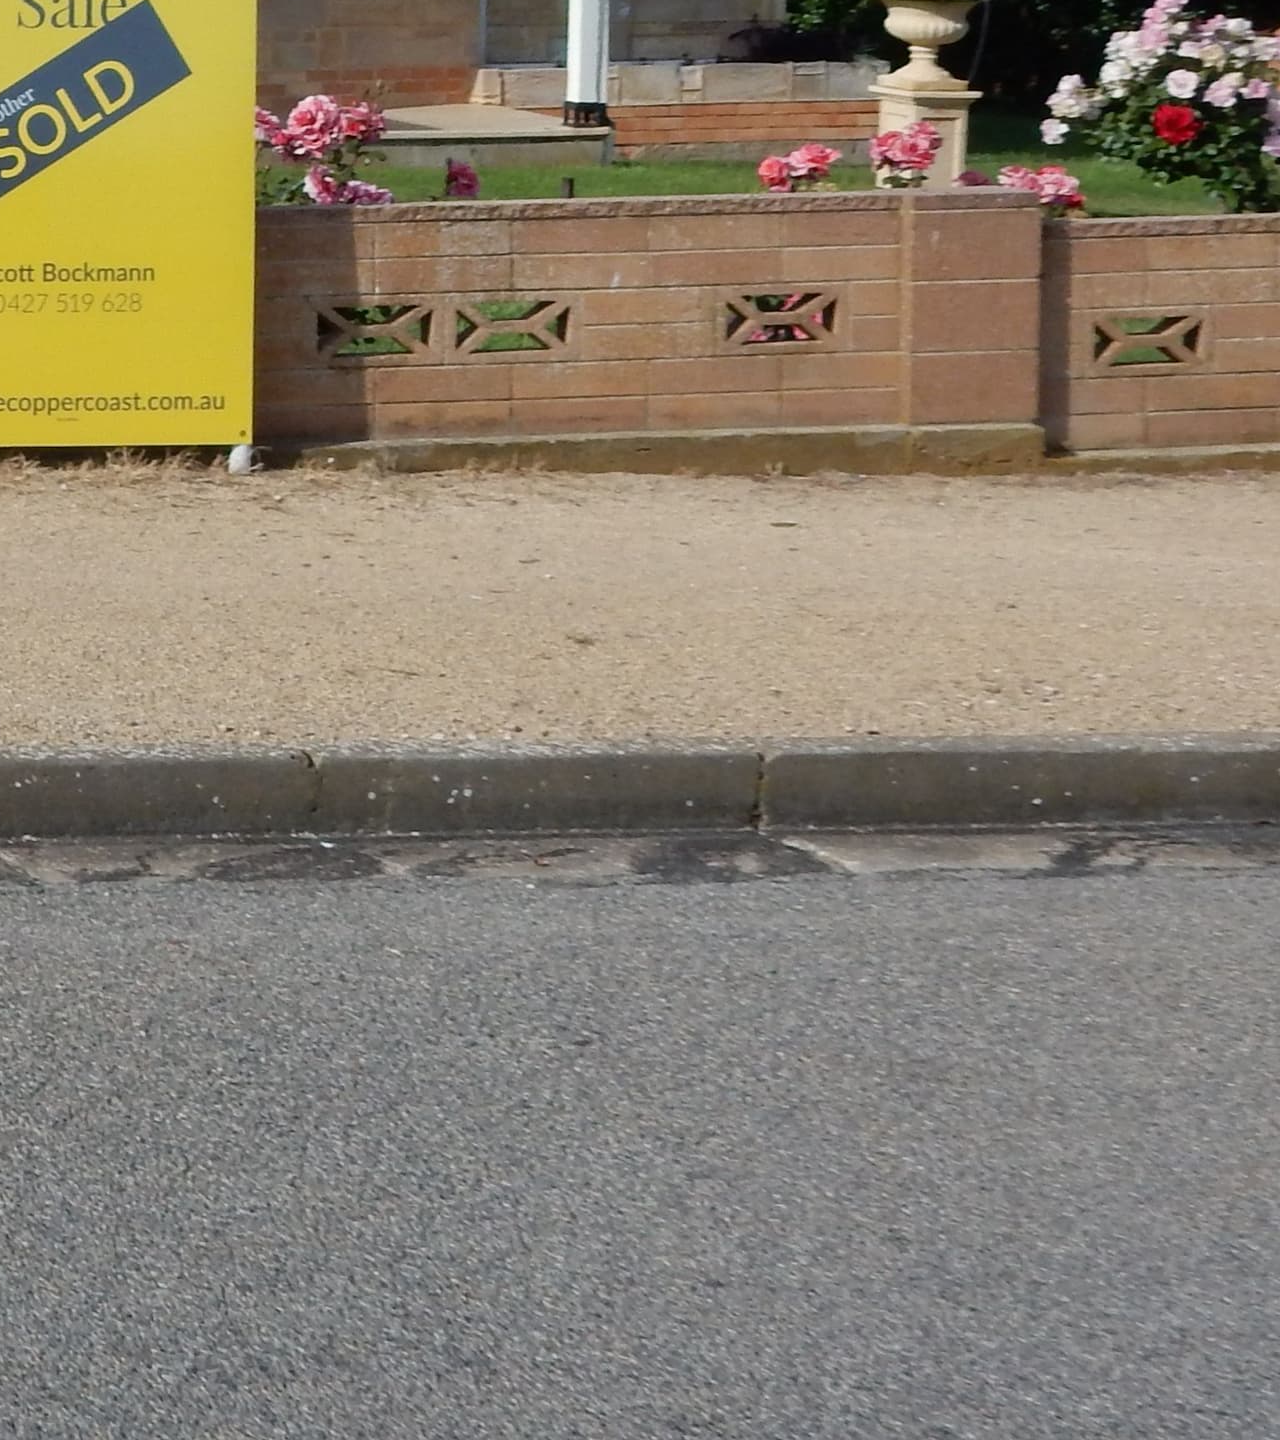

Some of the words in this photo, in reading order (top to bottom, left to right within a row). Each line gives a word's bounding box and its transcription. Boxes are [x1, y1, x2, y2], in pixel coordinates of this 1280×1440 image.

[42, 262, 156, 283] Bockmann
[56, 293, 94, 313] 519
[102, 293, 143, 313] 628
